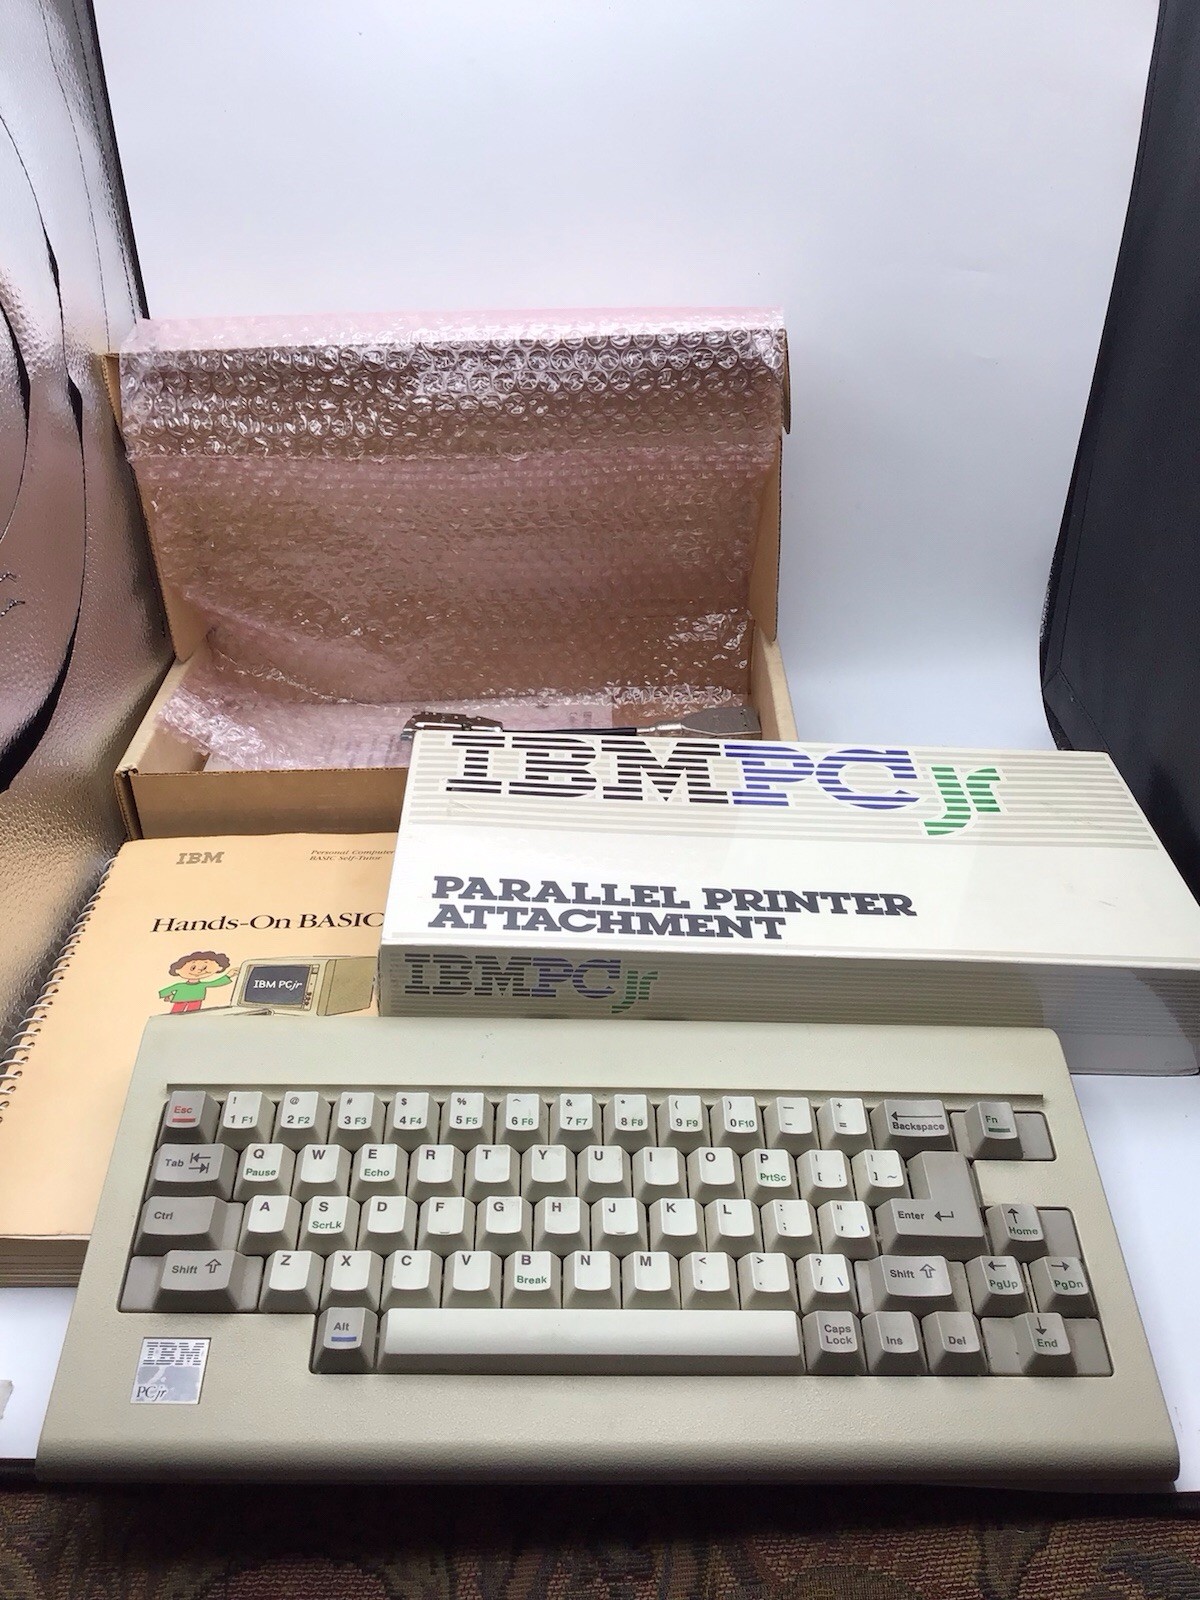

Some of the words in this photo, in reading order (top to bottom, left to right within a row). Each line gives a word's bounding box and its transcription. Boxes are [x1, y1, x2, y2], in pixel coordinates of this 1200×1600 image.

[176, 852, 224, 864] IBM
[431, 876, 690, 910] PARALLEL
[703, 887, 917, 916] PRINTER
[150, 914, 290, 932] Hands-On
[297, 912, 384, 929] BASIC
[427, 906, 786, 940] ATTACHMENT
[253, 980, 276, 988] IBM
[457, 1098, 467, 1106] %
[174, 1106, 193, 1115] Esc
[230, 1116, 236, 1124] 1
[241, 1116, 253, 1124] F1
[287, 1115, 294, 1124] 2
[297, 1116, 310, 1124] F2
[344, 1116, 351, 1125] 3
[354, 1117, 367, 1125] F3
[399, 1116, 407, 1125] 4
[409, 1117, 422, 1125] F4
[456, 1116, 462, 1124] 5
[511, 1116, 518, 1125] 6
[566, 1117, 573, 1125] 7
[621, 1118, 628, 1126] 8
[676, 1118, 682, 1127] 9
[686, 1119, 698, 1127] F9
[730, 1119, 737, 1127] 0
[985, 1116, 998, 1124] Fn
[892, 1122, 945, 1131] Backspace
[252, 1149, 264, 1160] Q
[312, 1150, 326, 1159] W
[368, 1150, 377, 1159] E
[425, 1150, 436, 1160] R
[483, 1150, 491, 1160] T
[538, 1150, 548, 1159] Y
[594, 1151, 604, 1160] U
[760, 1153, 768, 1163] P
[165, 1158, 184, 1167] Tab
[246, 1168, 276, 1177] Pause
[364, 1168, 390, 1177] Echo
[760, 1173, 786, 1182] PrtSc
[260, 1202, 271, 1212] A
[319, 1202, 329, 1212] S
[377, 1202, 387, 1212] D
[436, 1202, 445, 1212] F
[493, 1202, 504, 1212] G
[552, 1203, 561, 1212] H
[609, 1203, 616, 1213] J
[666, 1203, 677, 1213] K
[723, 1205, 732, 1214] L
[154, 1211, 173, 1220] Ctrl
[898, 1211, 925, 1220] Enter
[312, 1220, 341, 1230] ScrLk
[1009, 1227, 1038, 1235] Home
[281, 1255, 291, 1265] Z
[341, 1255, 352, 1266] X
[401, 1255, 412, 1266] C
[462, 1256, 471, 1265] V
[522, 1256, 531, 1265] B
[581, 1256, 591, 1266] N
[640, 1256, 652, 1266] M
[172, 1264, 198, 1274] Shift
[890, 1270, 915, 1278] Shift
[517, 1276, 547, 1284] Break
[989, 1280, 1018, 1289] PgUp
[1054, 1280, 1084, 1289] PgDn
[333, 1322, 349, 1331] Alt
[825, 1325, 851, 1335] Caps
[826, 1336, 852, 1345] Lock
[887, 1337, 903, 1345] Ins
[949, 1336, 966, 1345] Del
[1037, 1338, 1058, 1348] End
[143, 1342, 205, 1365] IBM
